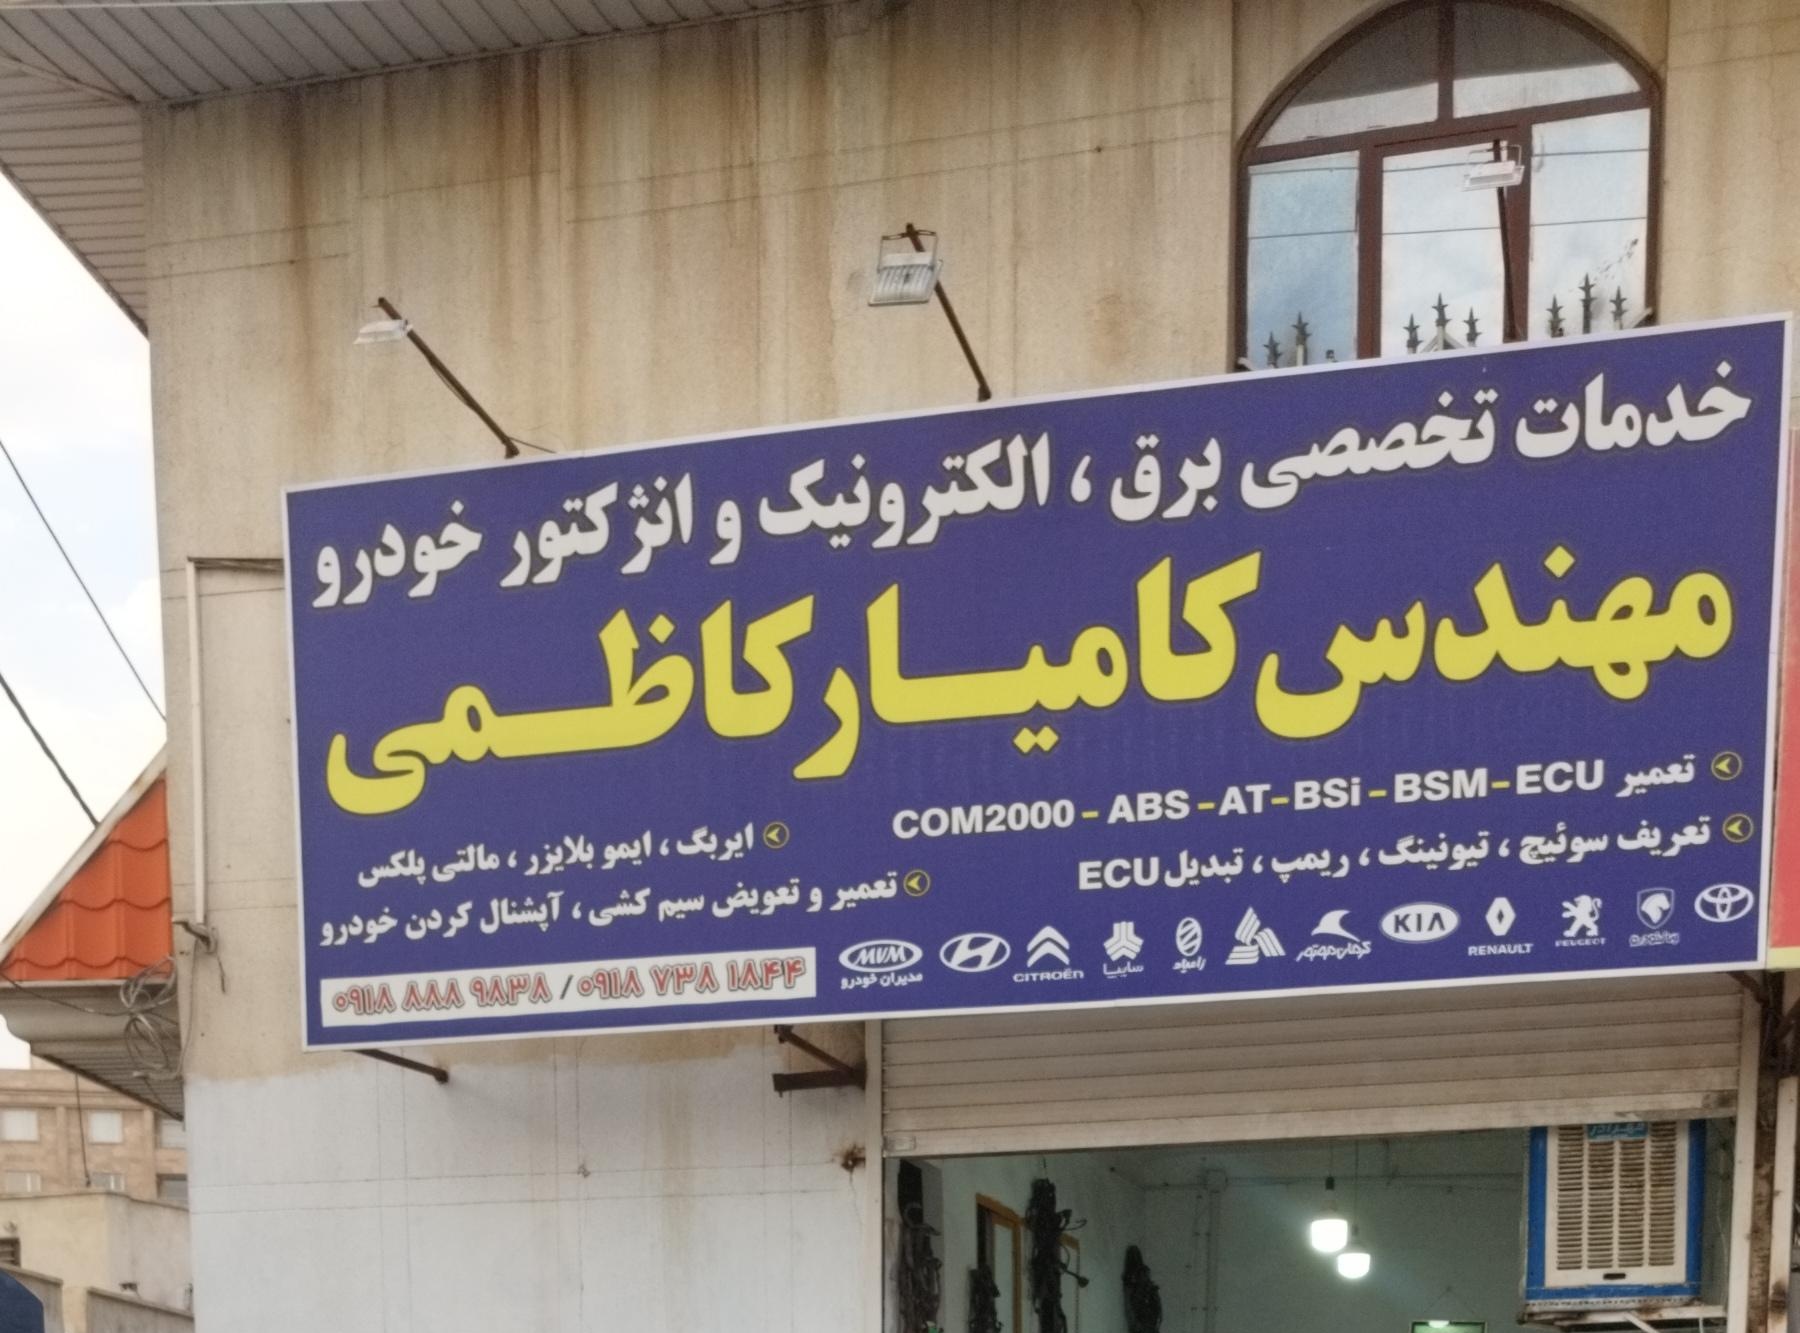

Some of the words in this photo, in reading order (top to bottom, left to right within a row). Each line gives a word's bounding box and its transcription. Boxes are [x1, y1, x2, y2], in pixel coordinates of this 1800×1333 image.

[1515, 361, 1752, 458] خدمات
[1240, 388, 1499, 509] تخصصی
[758, 432, 1050, 549] الکترونیک
[1110, 434, 1222, 522] برق
[499, 472, 693, 588] انژکتور
[709, 500, 742, 565] و
[312, 500, 483, 608] خودرو
[1255, 547, 1732, 738] مهندس
[1394, 767, 1488, 803] BSM
[1516, 759, 1604, 795] ECU
[1615, 753, 1696, 798] تعمیر
[892, 799, 1075, 839] COM2000
[1107, 789, 1190, 824] ABS
[1218, 783, 1272, 815] AT
[524, 834, 595, 876] بلایزر
[601, 830, 652, 870] ایمو
[676, 822, 754, 861] ایربگ
[1378, 830, 1490, 871] تیونینگ
[1519, 821, 1609, 865] سوئیچ
[1616, 815, 1711, 857] تعریف
[358, 849, 427, 888] پلکس
[431, 843, 500, 882] مالتی
[1078, 856, 1160, 890] ECU
[1164, 847, 1244, 888] تبدیل
[1271, 849, 1350, 884] ریمپ
[588, 887, 651, 927] کشی
[658, 895, 705, 922] سیم
[711, 878, 800, 918] تعویض
[806, 887, 823, 913] و
[829, 871, 898, 911] تعمیر
[319, 907, 398, 946] خودرو
[405, 901, 473, 940] کردن
[479, 890, 564, 934] آپشنال
[1393, 911, 1446, 933] KIA
[853, 944, 908, 965] MVM
[1467, 943, 1533, 957] RENAULT
[840, 972, 878, 990] خودرو
